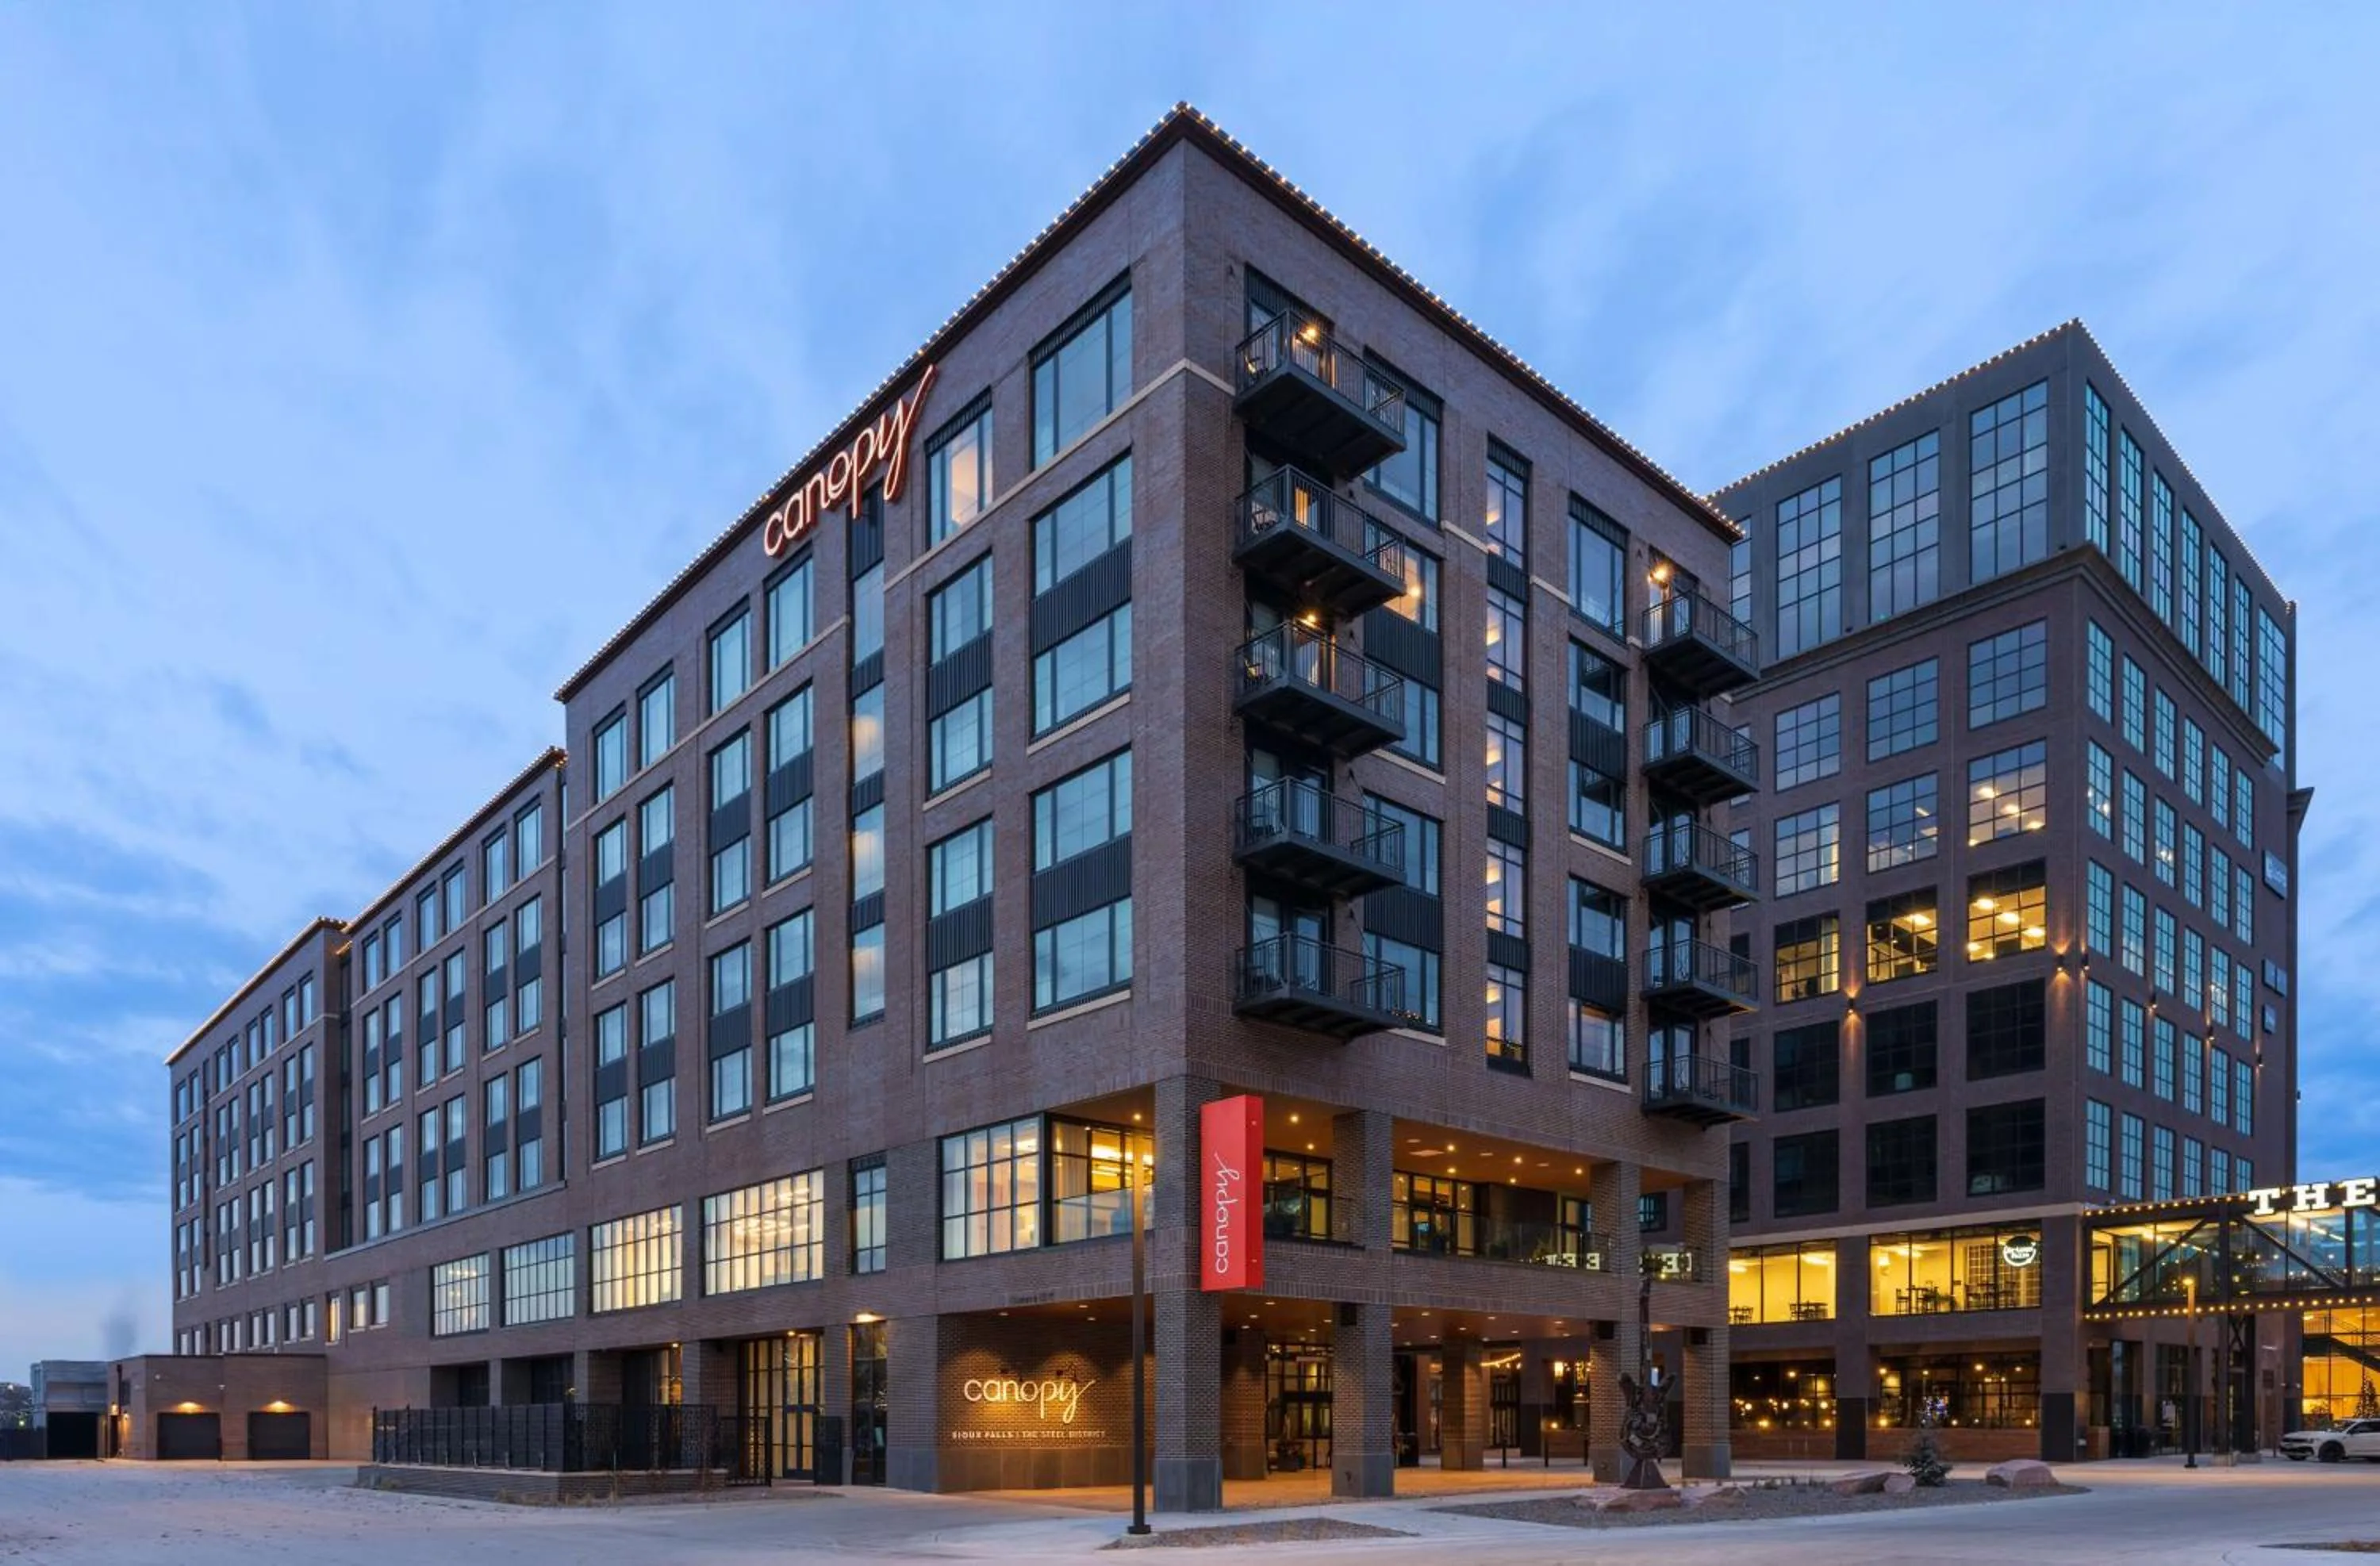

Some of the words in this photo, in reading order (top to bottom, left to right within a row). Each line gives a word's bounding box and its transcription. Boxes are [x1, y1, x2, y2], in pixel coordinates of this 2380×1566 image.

[763, 363, 939, 557] canopy
[1215, 1150, 1240, 1274] canopy
[2248, 1177, 2376, 1216] THE
[963, 1379, 1096, 1423] canopy
[952, 1430, 981, 1439] SIOUX
